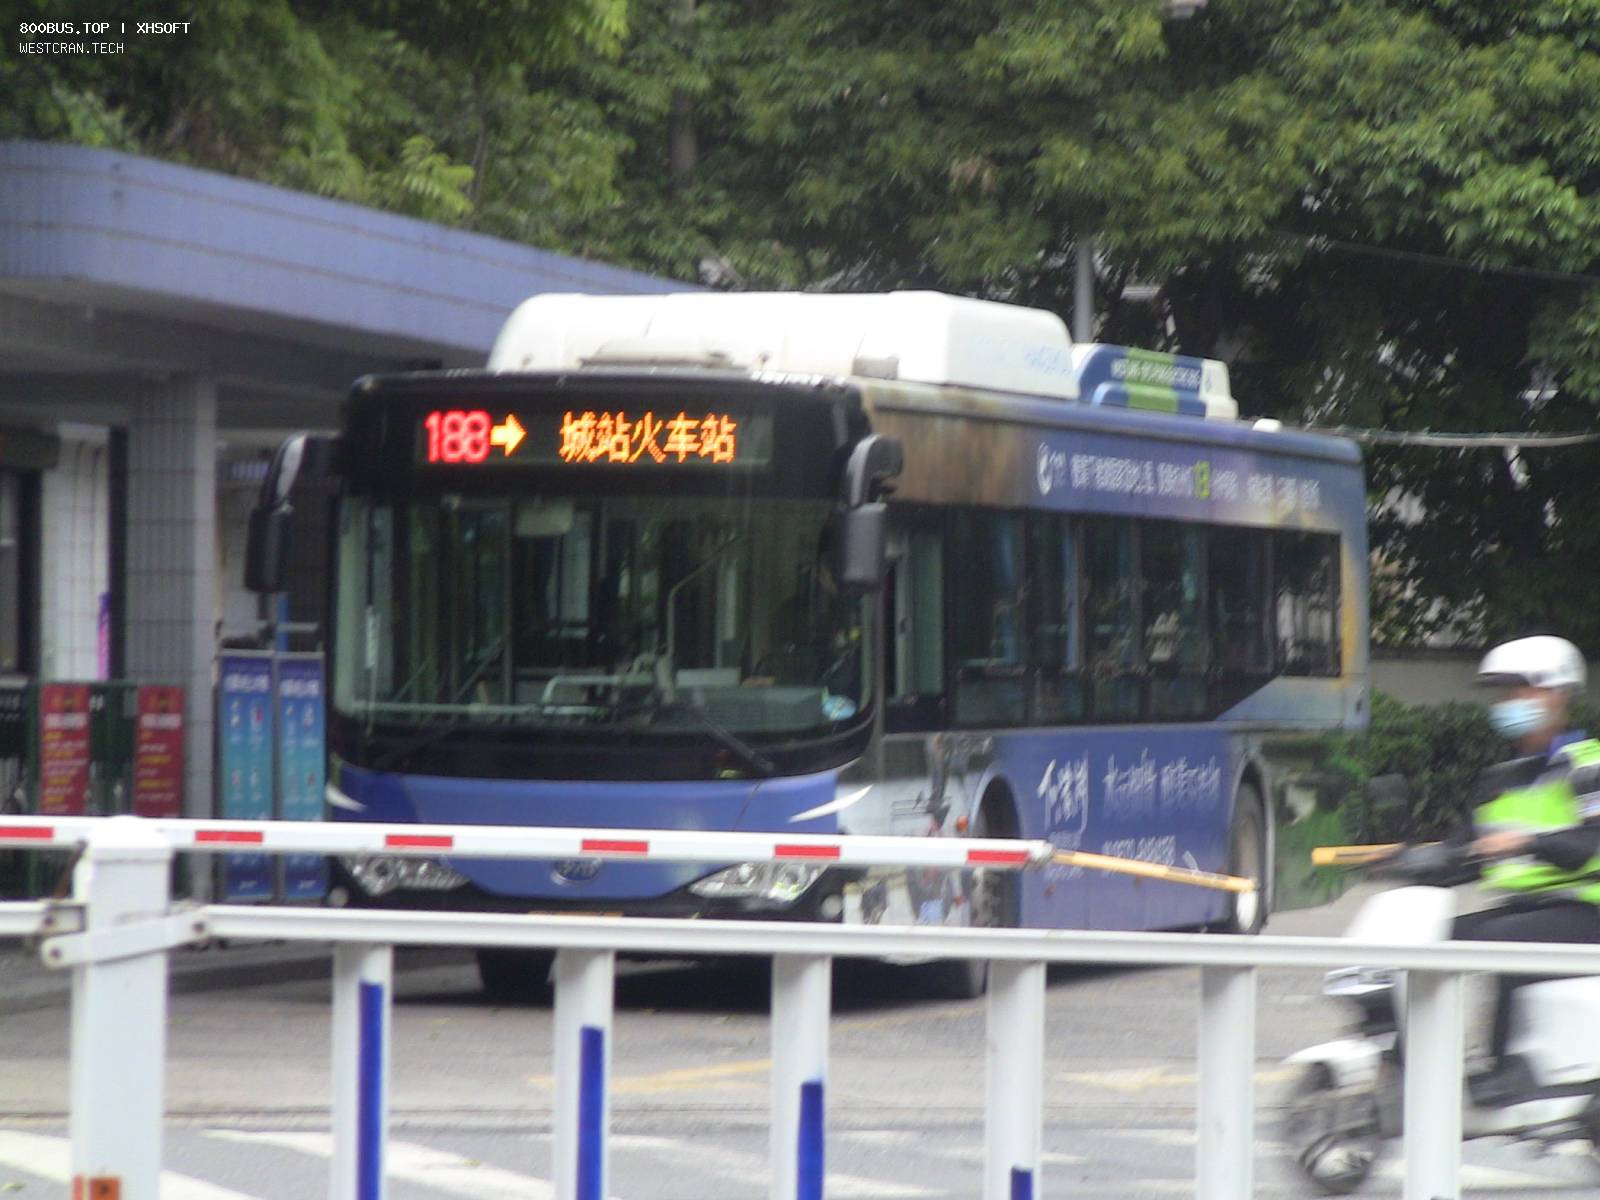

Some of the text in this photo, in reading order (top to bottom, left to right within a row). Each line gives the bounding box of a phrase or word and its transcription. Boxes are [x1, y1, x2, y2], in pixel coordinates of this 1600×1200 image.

[425, 410, 491, 463] 188
[558, 410, 737, 463] 城站火车站
